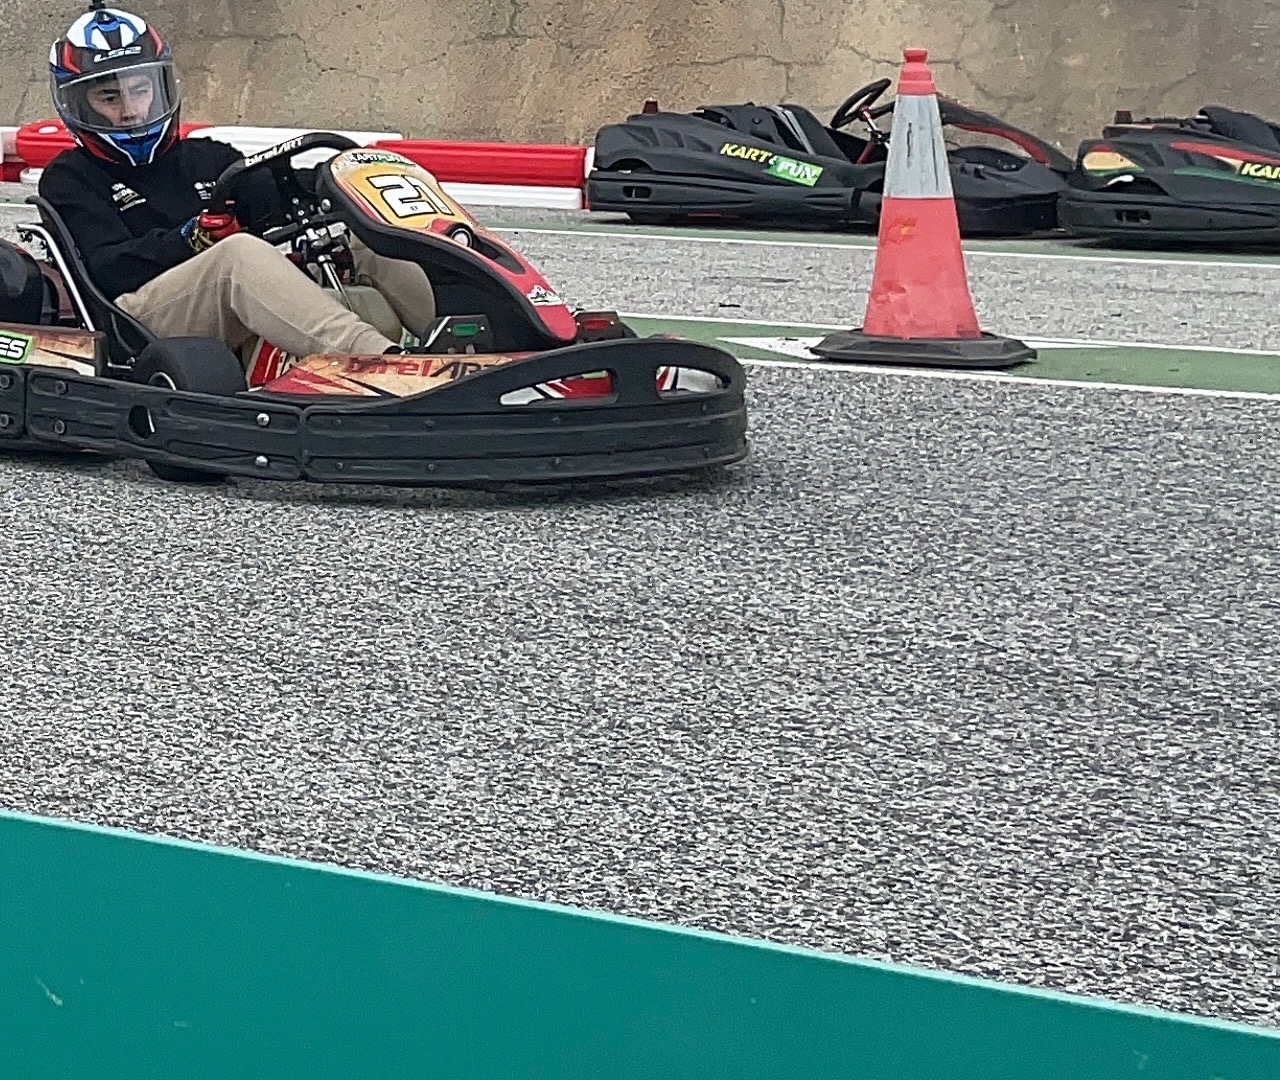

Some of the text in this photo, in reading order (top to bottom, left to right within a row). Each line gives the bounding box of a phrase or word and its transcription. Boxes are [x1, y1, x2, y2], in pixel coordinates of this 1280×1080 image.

[93, 46, 142, 63] LS2
[244, 136, 305, 167] birelART
[720, 142, 773, 163] KART
[366, 174, 455, 218] 21
